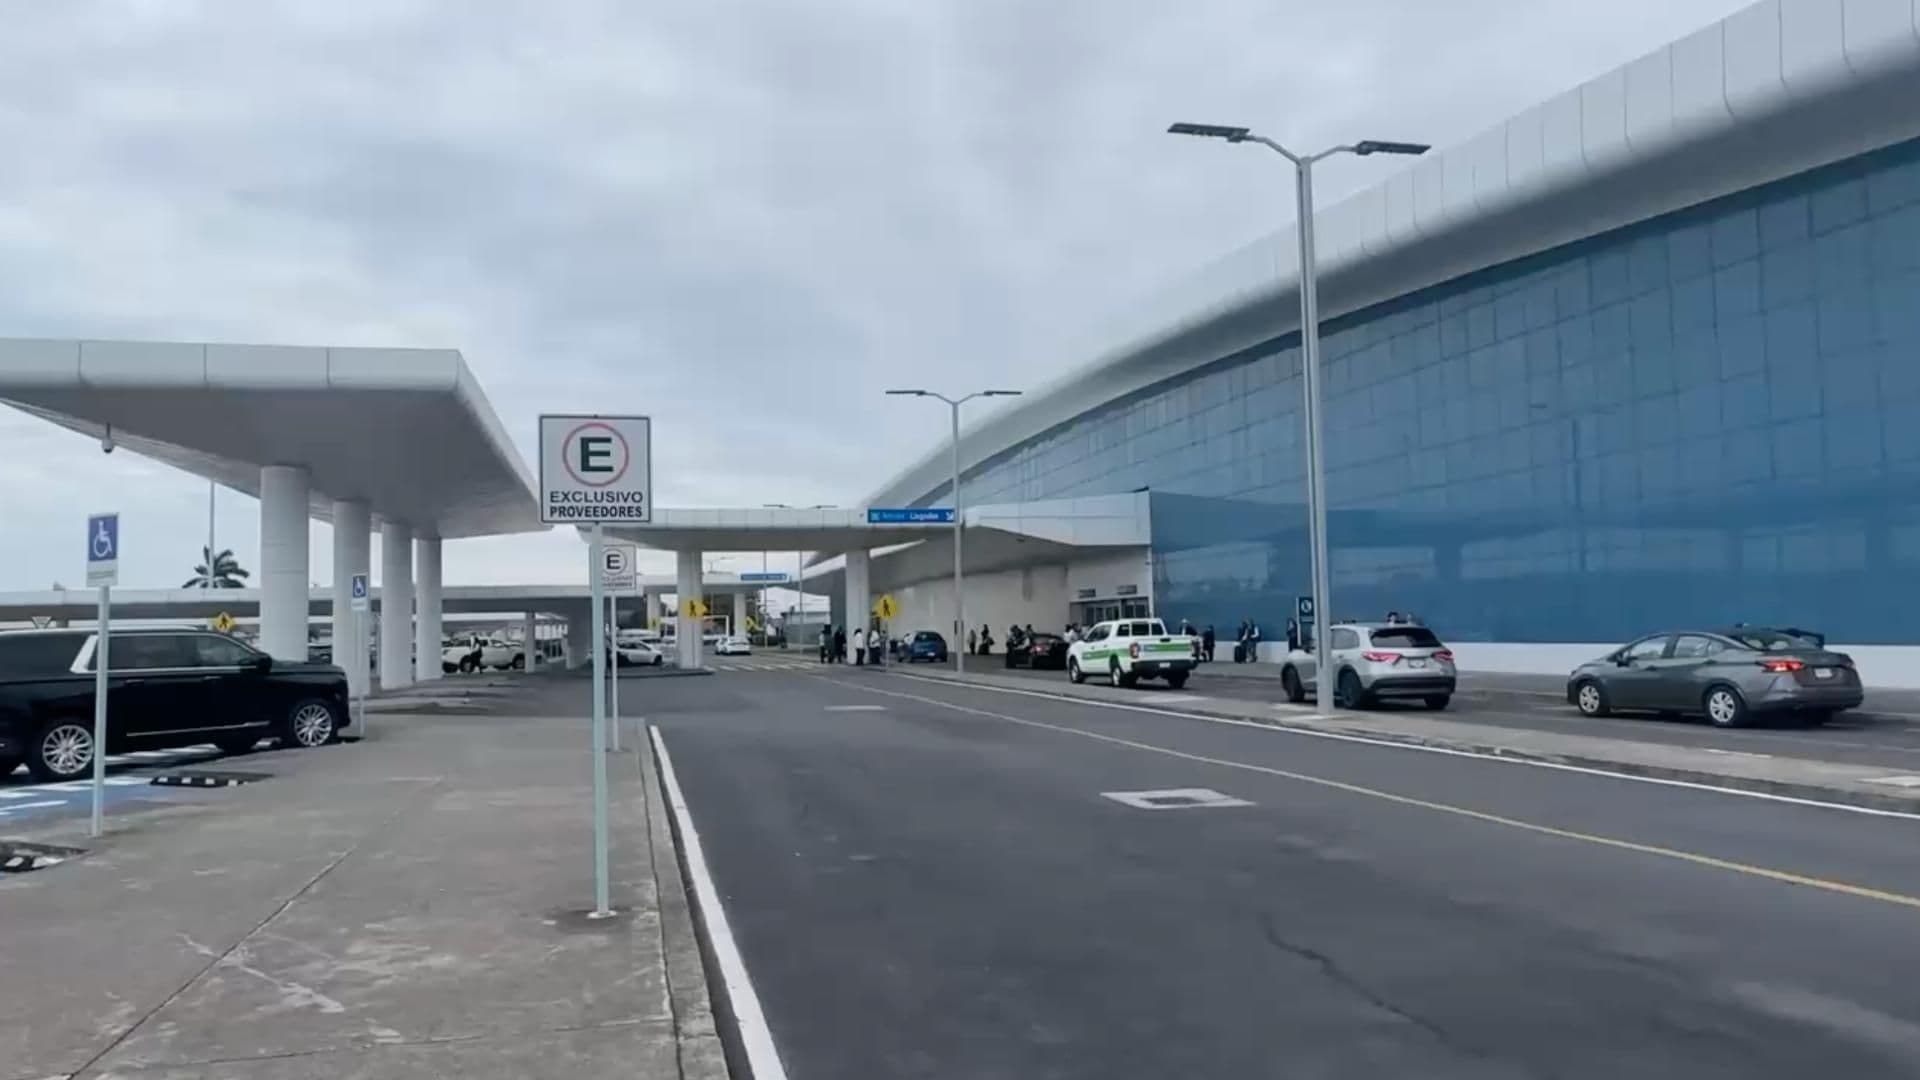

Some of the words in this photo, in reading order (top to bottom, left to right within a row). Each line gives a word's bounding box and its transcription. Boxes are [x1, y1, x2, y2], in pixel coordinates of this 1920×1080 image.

[580, 437, 614, 472] E
[550, 491, 643, 503] EXCLUSIVO
[550, 506, 642, 518] PROVEEDORES
[606, 554, 621, 570] E
